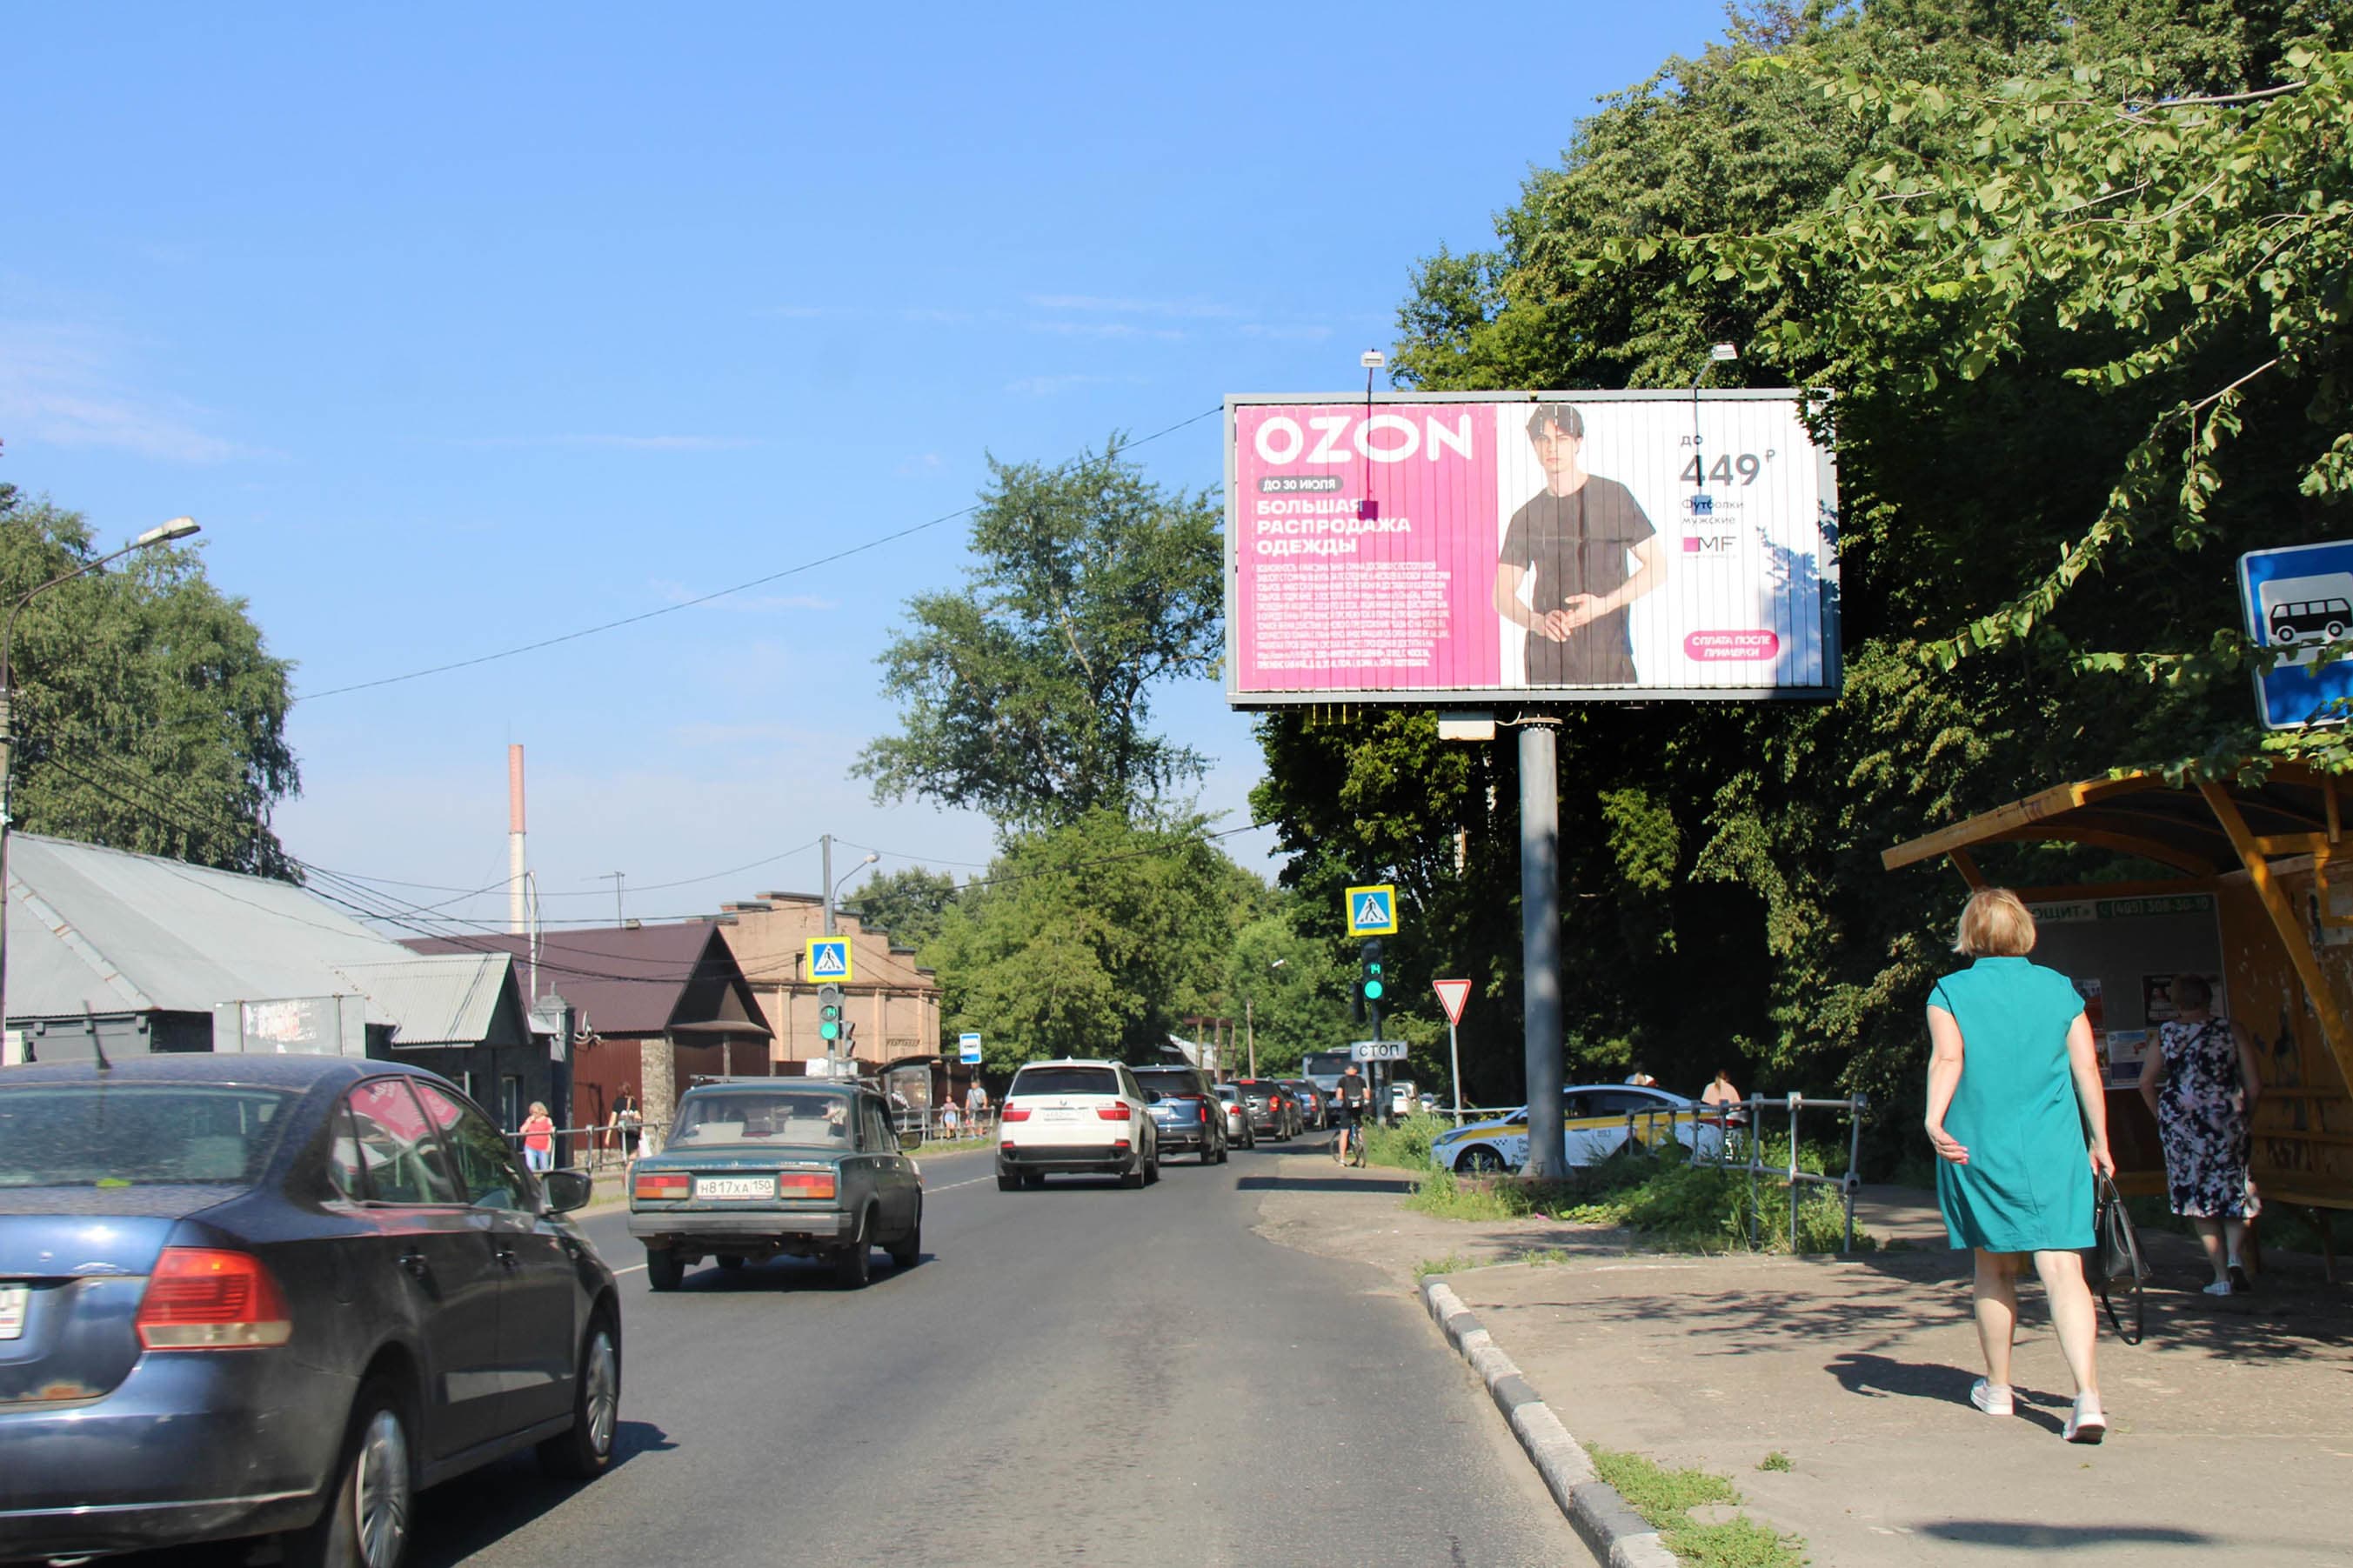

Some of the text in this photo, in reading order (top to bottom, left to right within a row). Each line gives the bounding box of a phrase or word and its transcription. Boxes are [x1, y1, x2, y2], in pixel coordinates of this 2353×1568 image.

[1255, 414, 1473, 464] OZON
[1680, 453, 1761, 487] 449
[1263, 479, 1336, 492] ДО 30 ИЮЛЯ
[1257, 498, 1363, 515] БОЛЬШАЯ
[1257, 518, 1412, 536] РАСПРОДАЖА
[1257, 537, 1357, 557] ОДЕЖДЫ
[1359, 1044, 1399, 1057] СТОП
